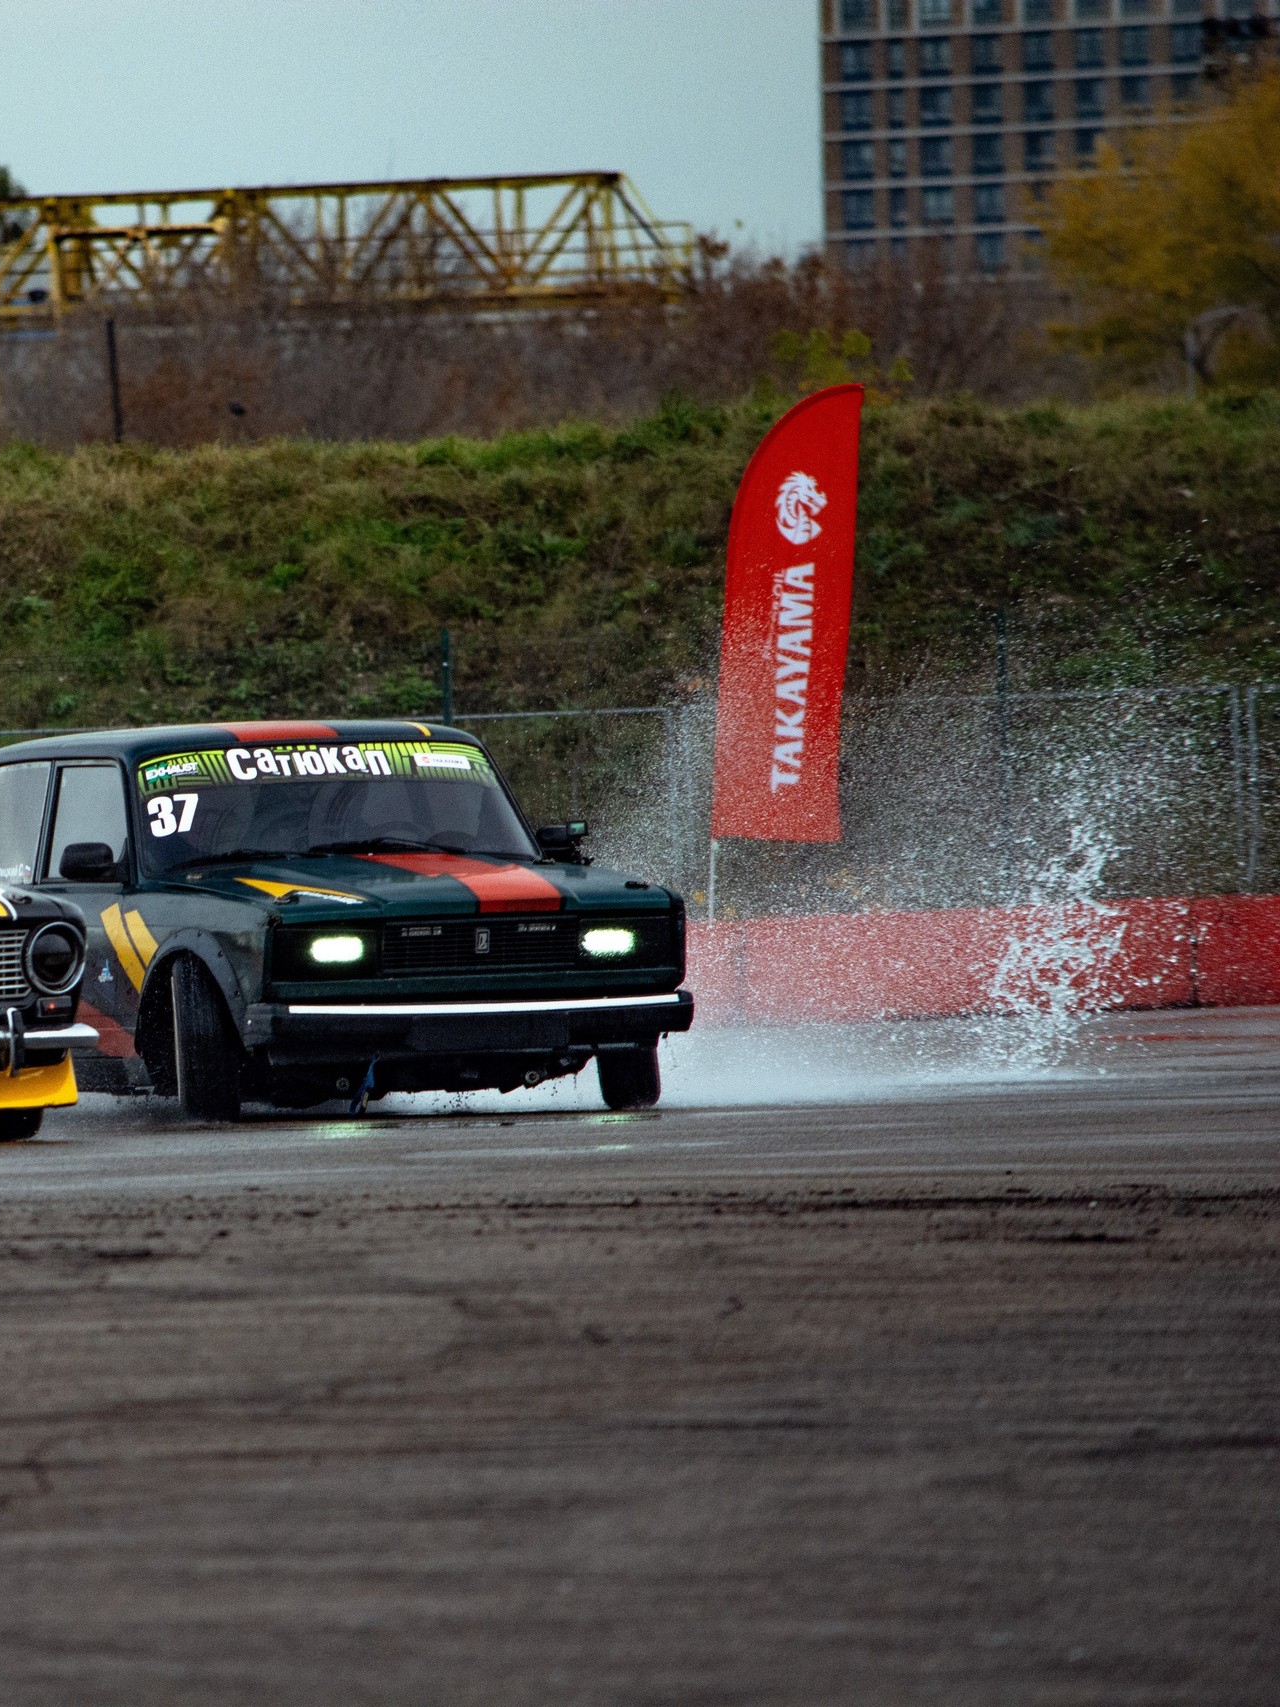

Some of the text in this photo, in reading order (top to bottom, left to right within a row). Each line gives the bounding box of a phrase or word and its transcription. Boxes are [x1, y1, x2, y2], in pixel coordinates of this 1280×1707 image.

[771, 562, 815, 793] TAKAYAMA
[145, 762, 199, 780] EXHAUST
[147, 793, 199, 837] 37
